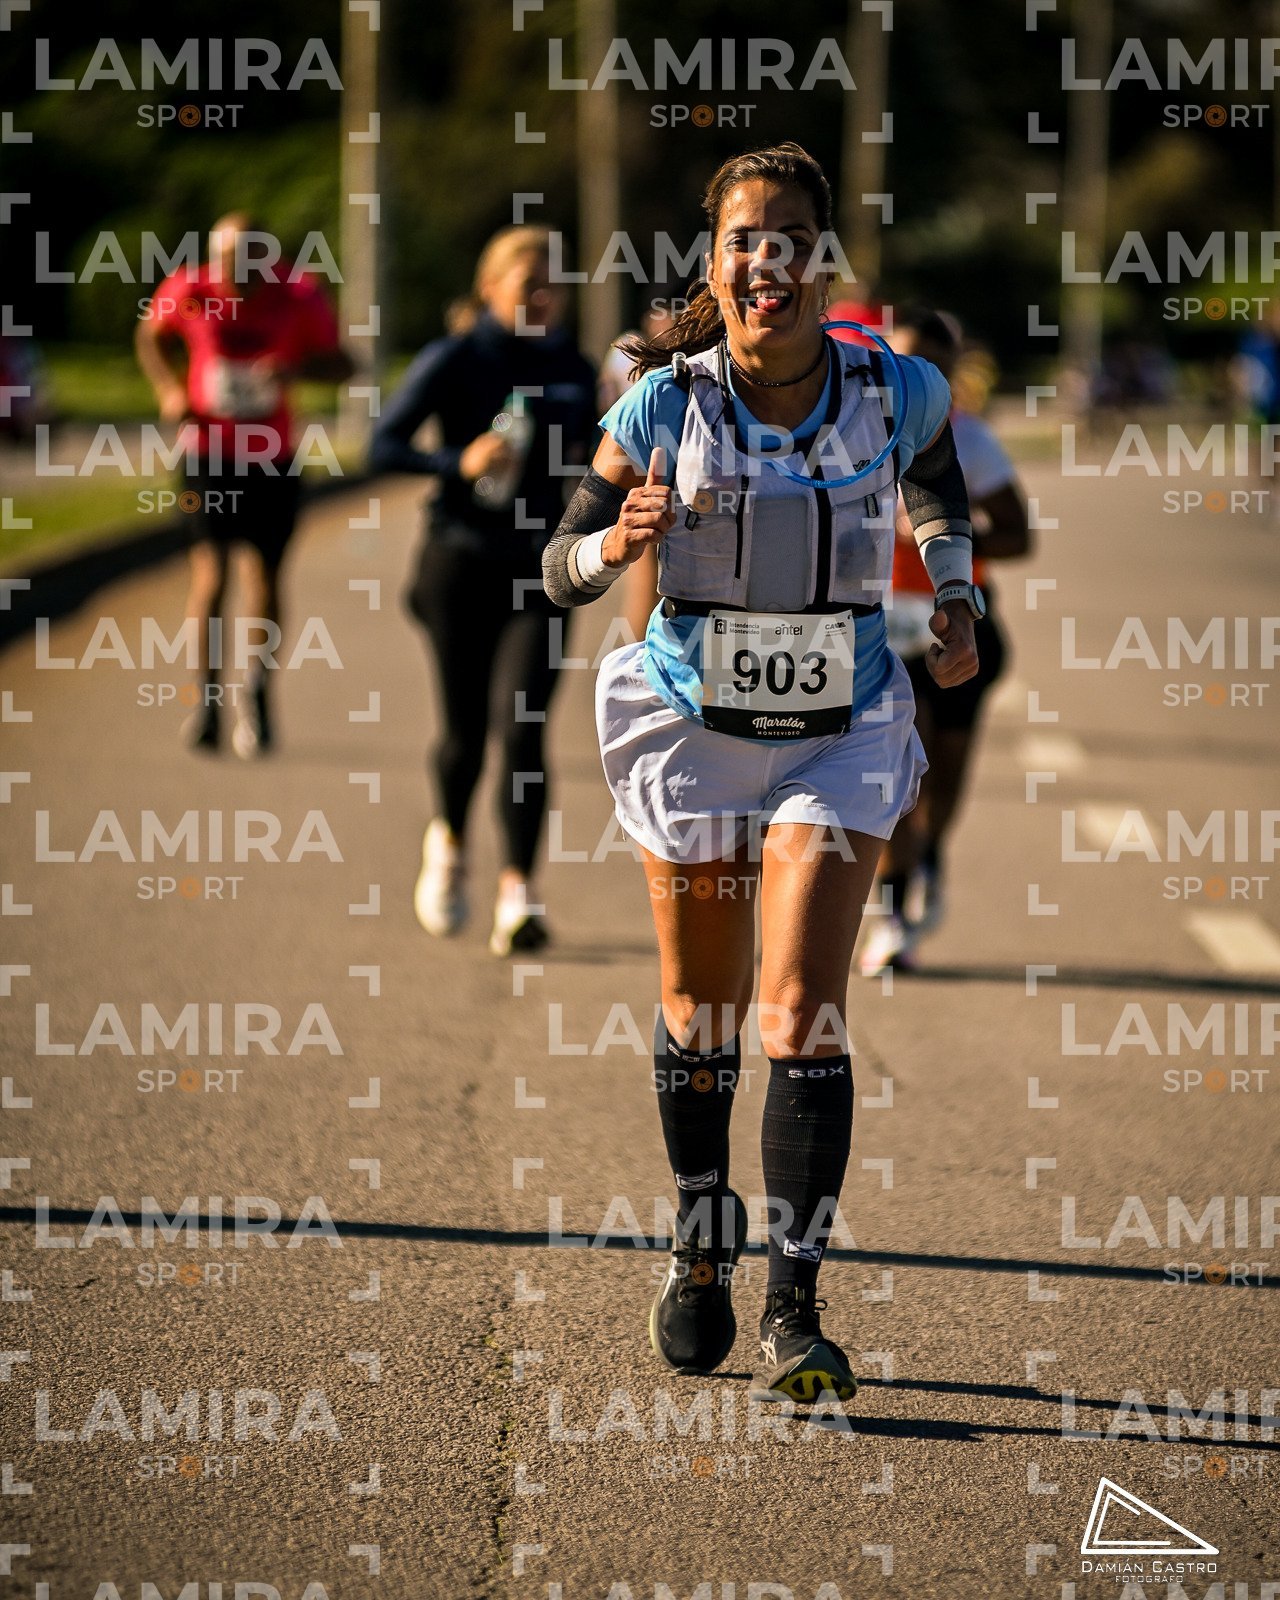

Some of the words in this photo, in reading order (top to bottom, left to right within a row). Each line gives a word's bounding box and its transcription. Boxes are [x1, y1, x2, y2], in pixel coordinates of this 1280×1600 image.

[732, 649, 828, 696] 903
[752, 716, 806, 729] Maratón
[788, 1066, 845, 1079] SOX
